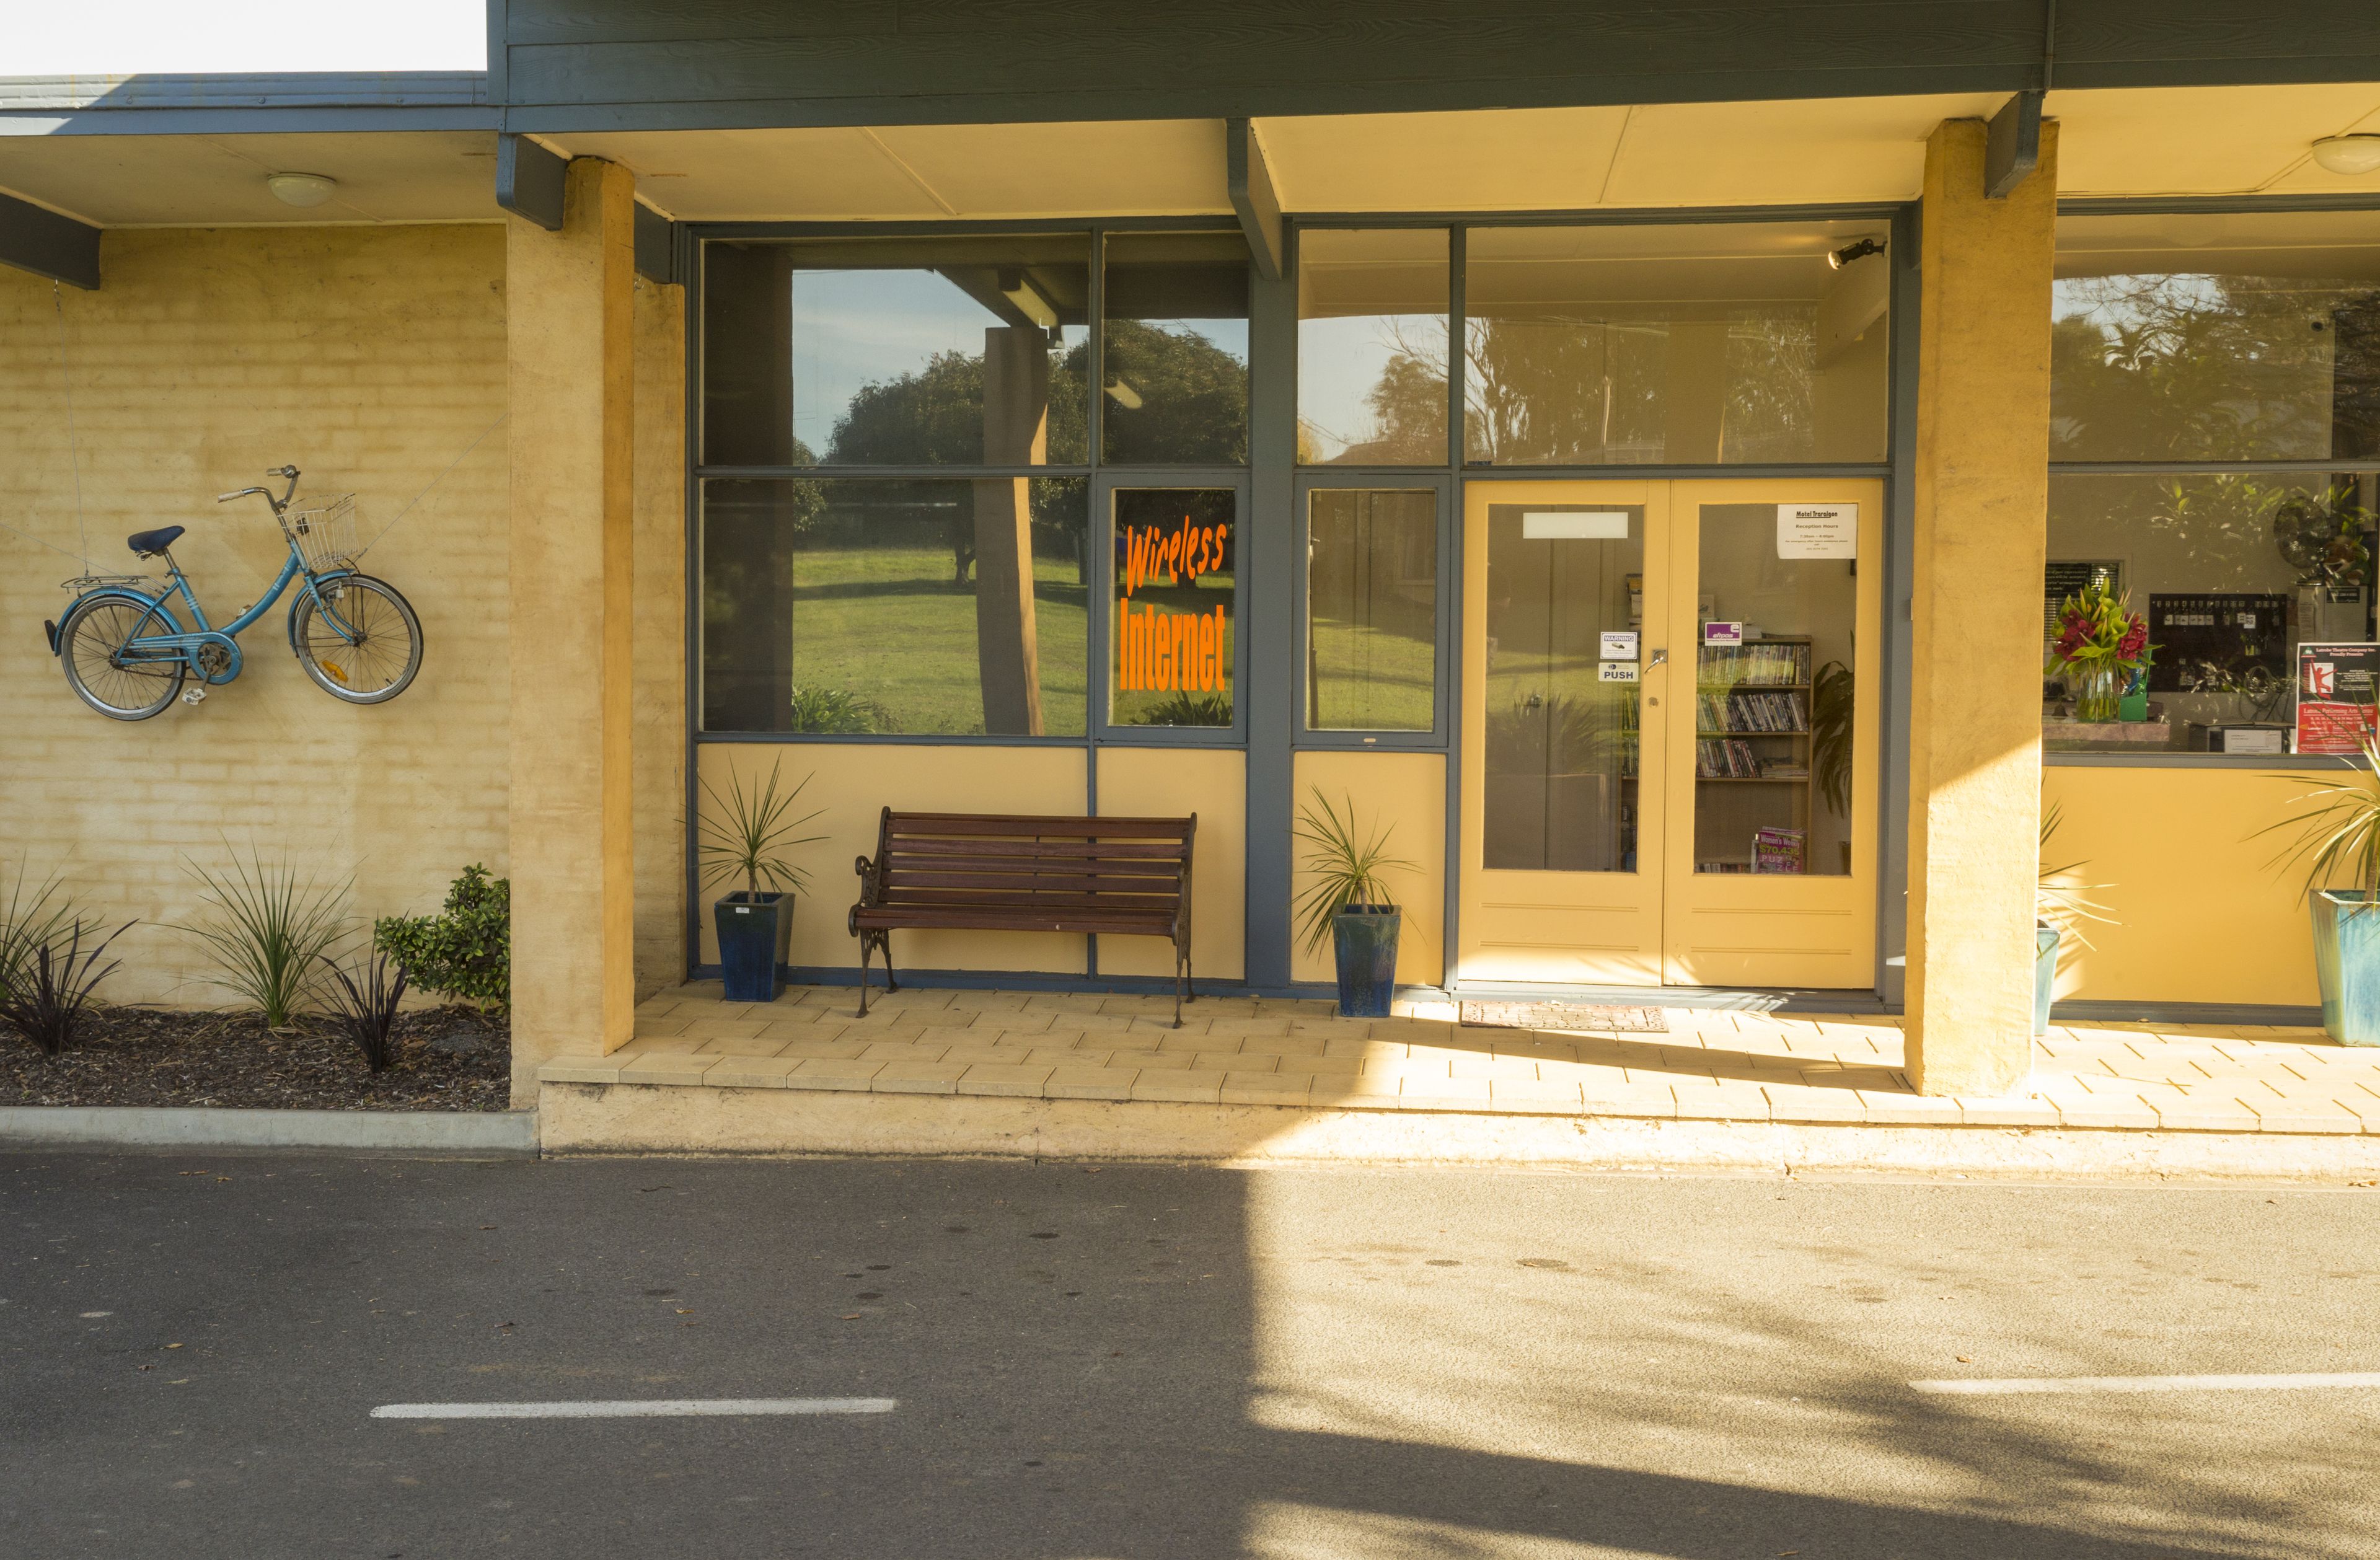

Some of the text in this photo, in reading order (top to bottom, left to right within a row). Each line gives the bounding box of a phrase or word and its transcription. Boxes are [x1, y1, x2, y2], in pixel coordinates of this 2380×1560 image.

[1813, 511, 1838, 519] Traralgon
[1127, 515, 1227, 596] Wireless
[2246, 617, 2254, 625] 12
[1120, 597, 1225, 692] Internet
[1760, 834, 1783, 845] Women's
